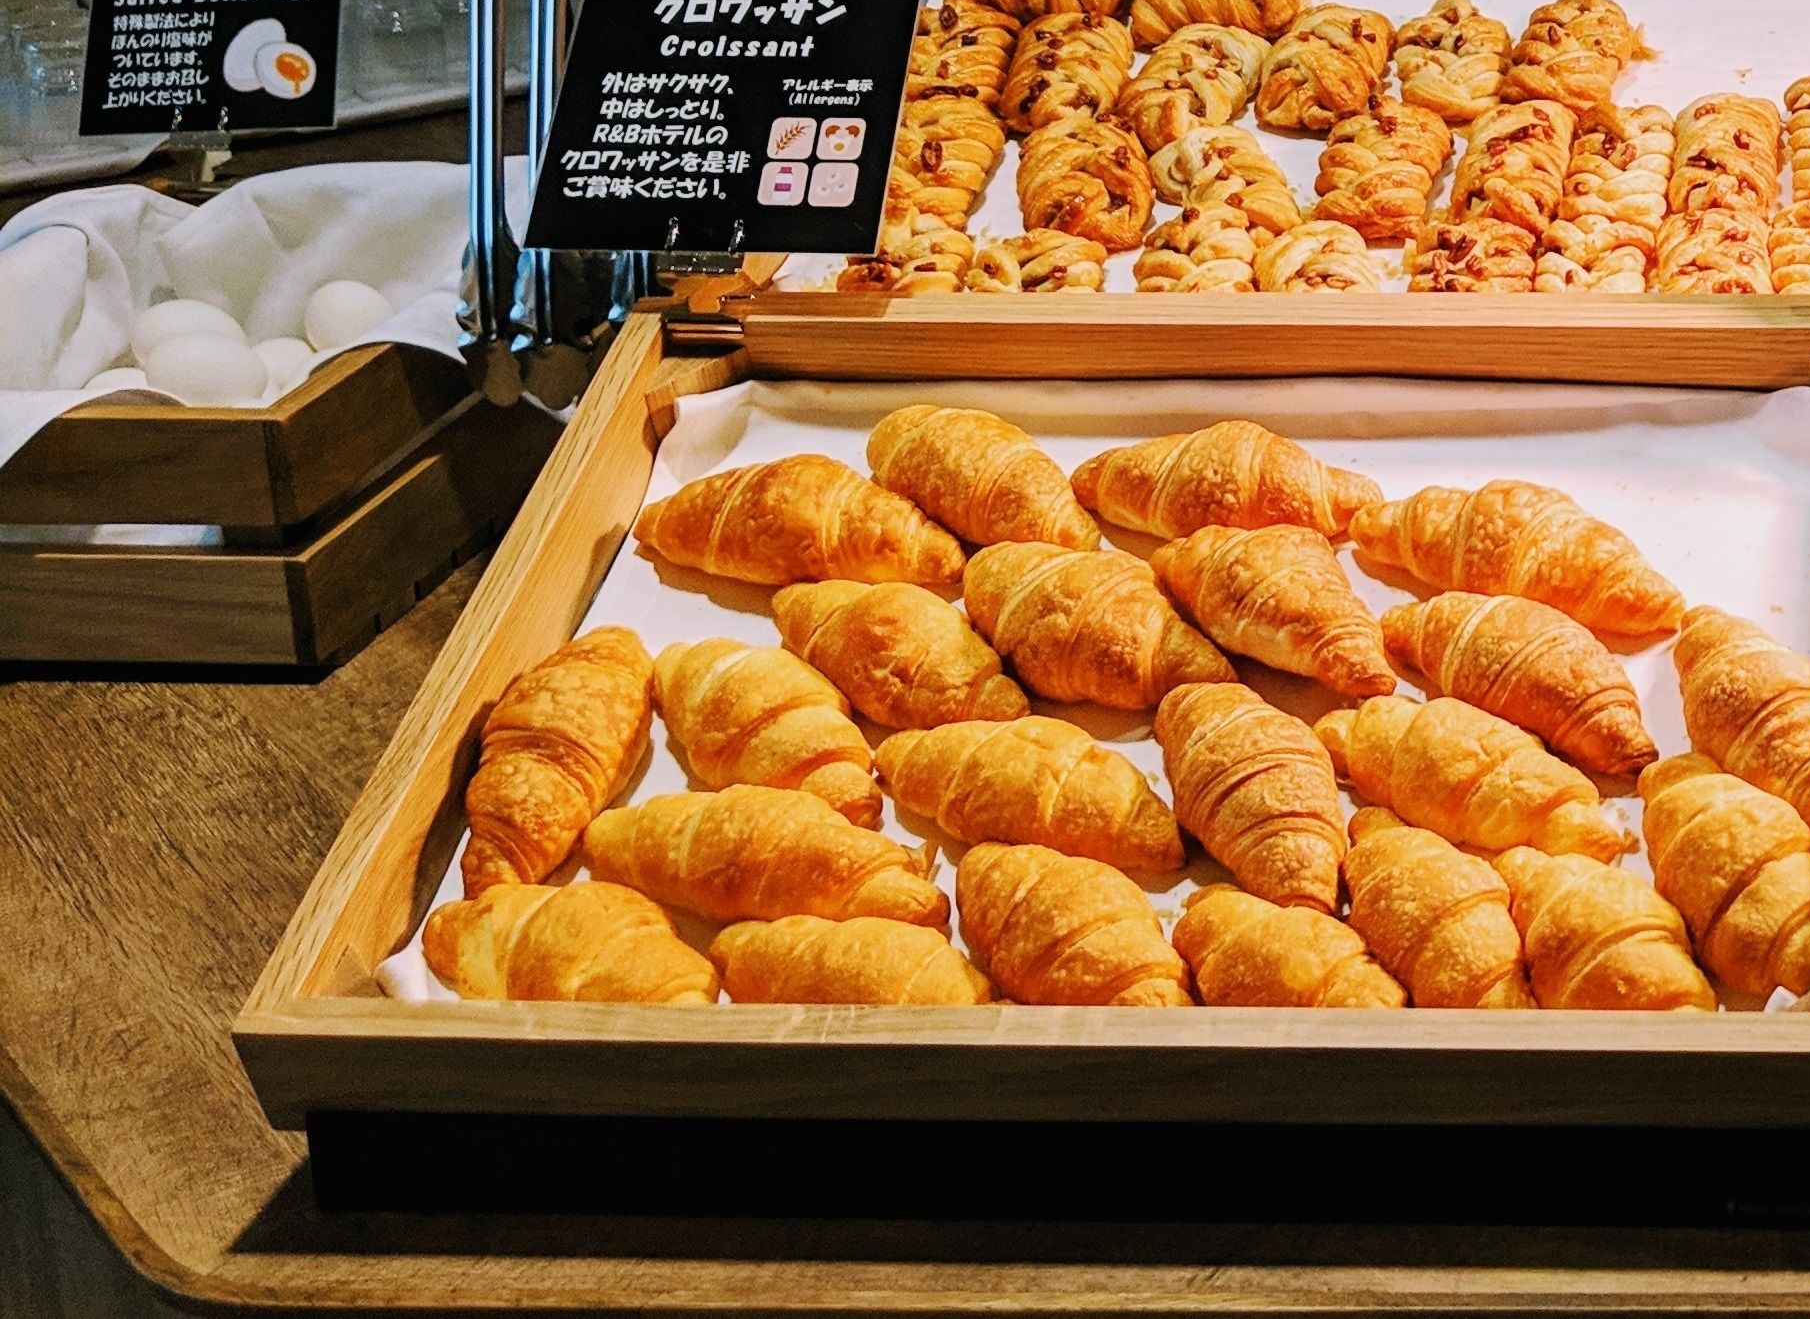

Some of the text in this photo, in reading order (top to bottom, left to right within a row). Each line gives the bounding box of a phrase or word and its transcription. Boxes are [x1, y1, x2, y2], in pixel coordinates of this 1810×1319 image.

[661, 35, 814, 56] Croissant
[602, 72, 733, 94] 外はサクサク、
[600, 97, 724, 120] 中はしっとり。
[593, 124, 728, 145] R&Bホテルの
[561, 150, 750, 173] クロワッサンを是非
[563, 175, 726, 199] ご賞味ください。
